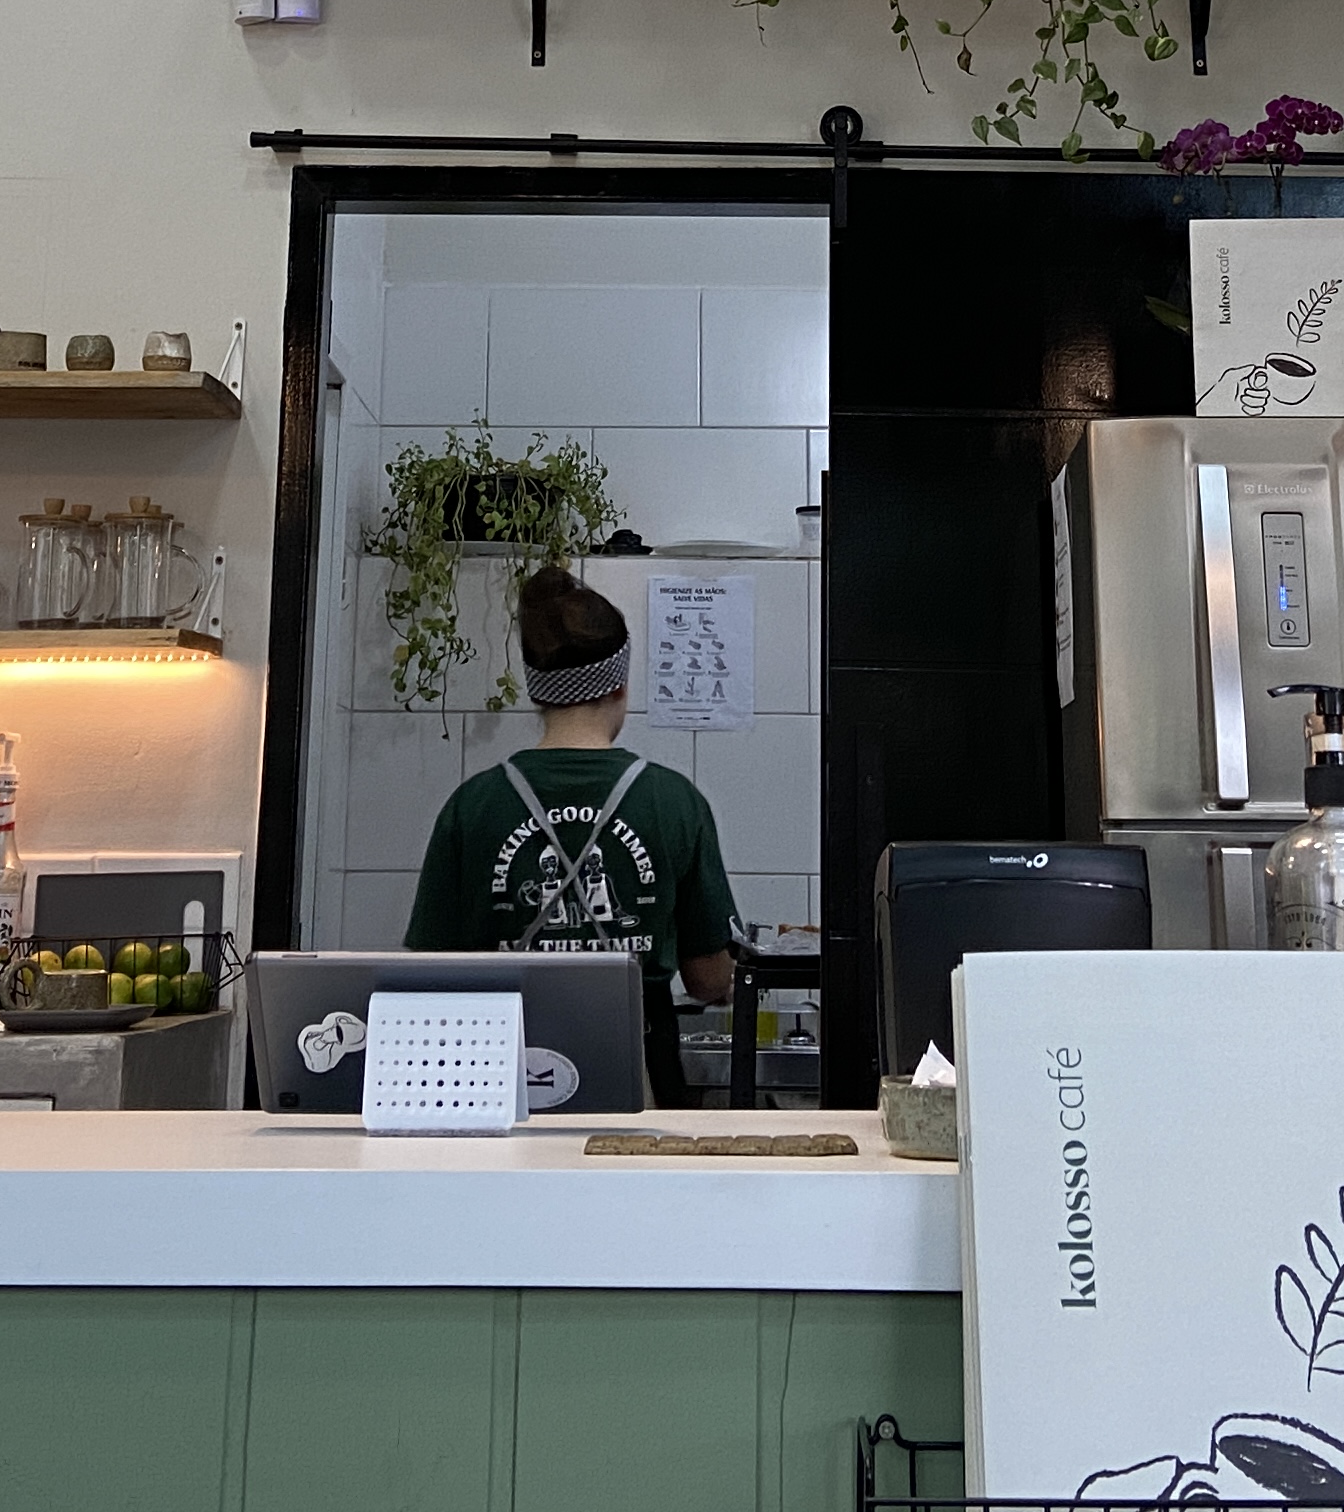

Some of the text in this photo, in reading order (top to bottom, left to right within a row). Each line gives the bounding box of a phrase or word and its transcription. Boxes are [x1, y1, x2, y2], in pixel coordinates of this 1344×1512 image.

[1216, 248, 1231, 324] kolosso café
[1257, 485, 1313, 495] Electrolux
[610, 818, 656, 885] TIMES
[989, 855, 1027, 864] bematech
[587, 935, 653, 952] TMES
[1046, 1046, 1096, 1309] kolosso café
